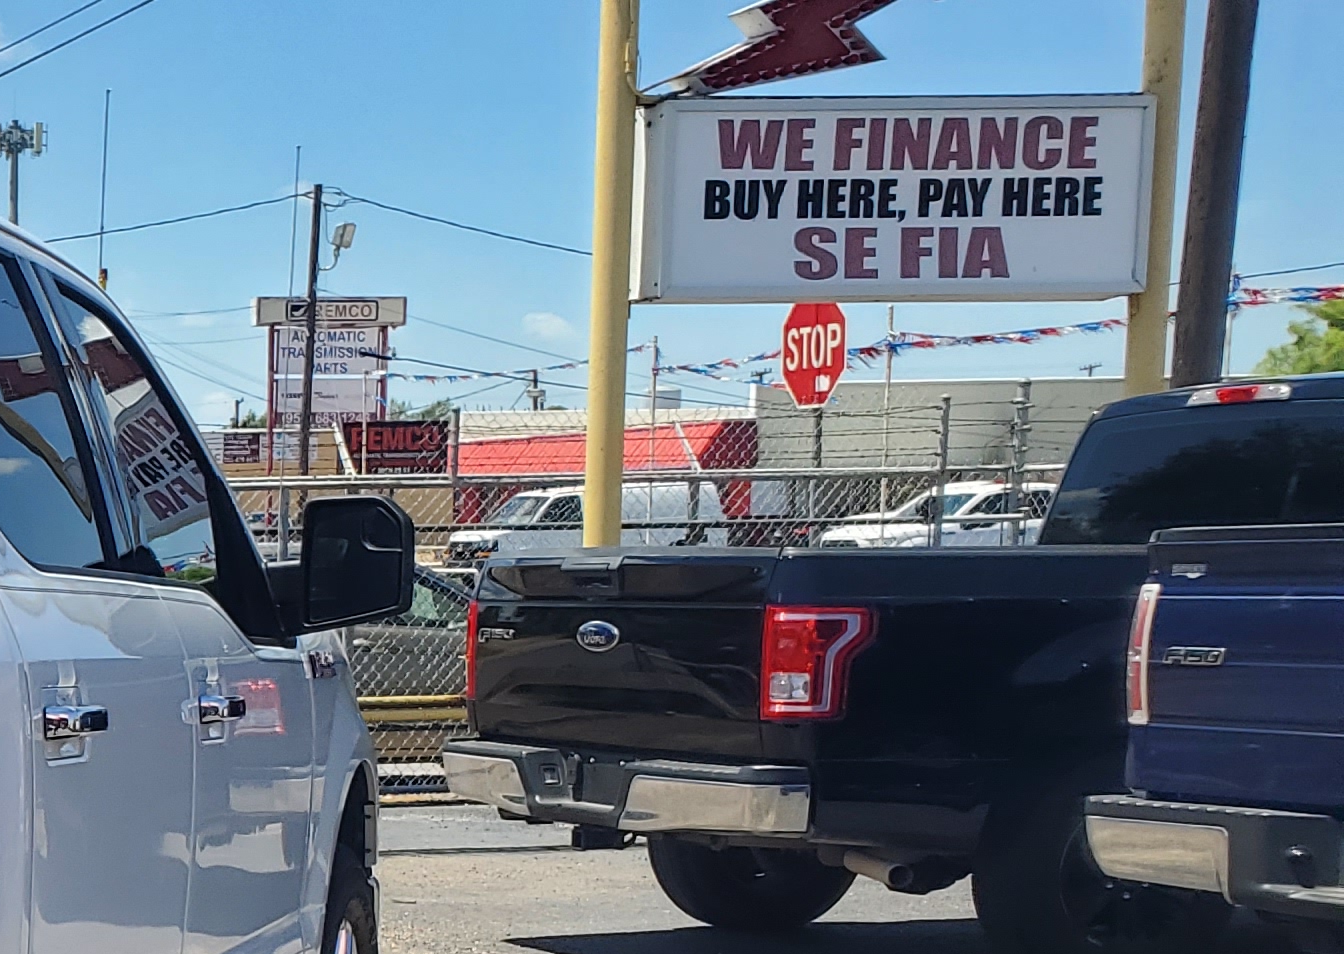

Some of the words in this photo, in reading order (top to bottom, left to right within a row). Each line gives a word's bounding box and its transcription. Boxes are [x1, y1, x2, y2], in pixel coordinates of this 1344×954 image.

[717, 118, 816, 171] WE
[833, 115, 1100, 171] FINANCE
[703, 178, 786, 221] BUY
[795, 177, 907, 223] HERE,
[917, 177, 995, 218] PAY
[1001, 175, 1103, 217] HERE
[793, 226, 878, 280] SE
[899, 225, 1010, 279] FIA
[280, 346, 377, 359] TRASMISSION
[291, 330, 366, 343] AOMATIC
[785, 322, 842, 372] STOP
[310, 361, 348, 374] ARTS
